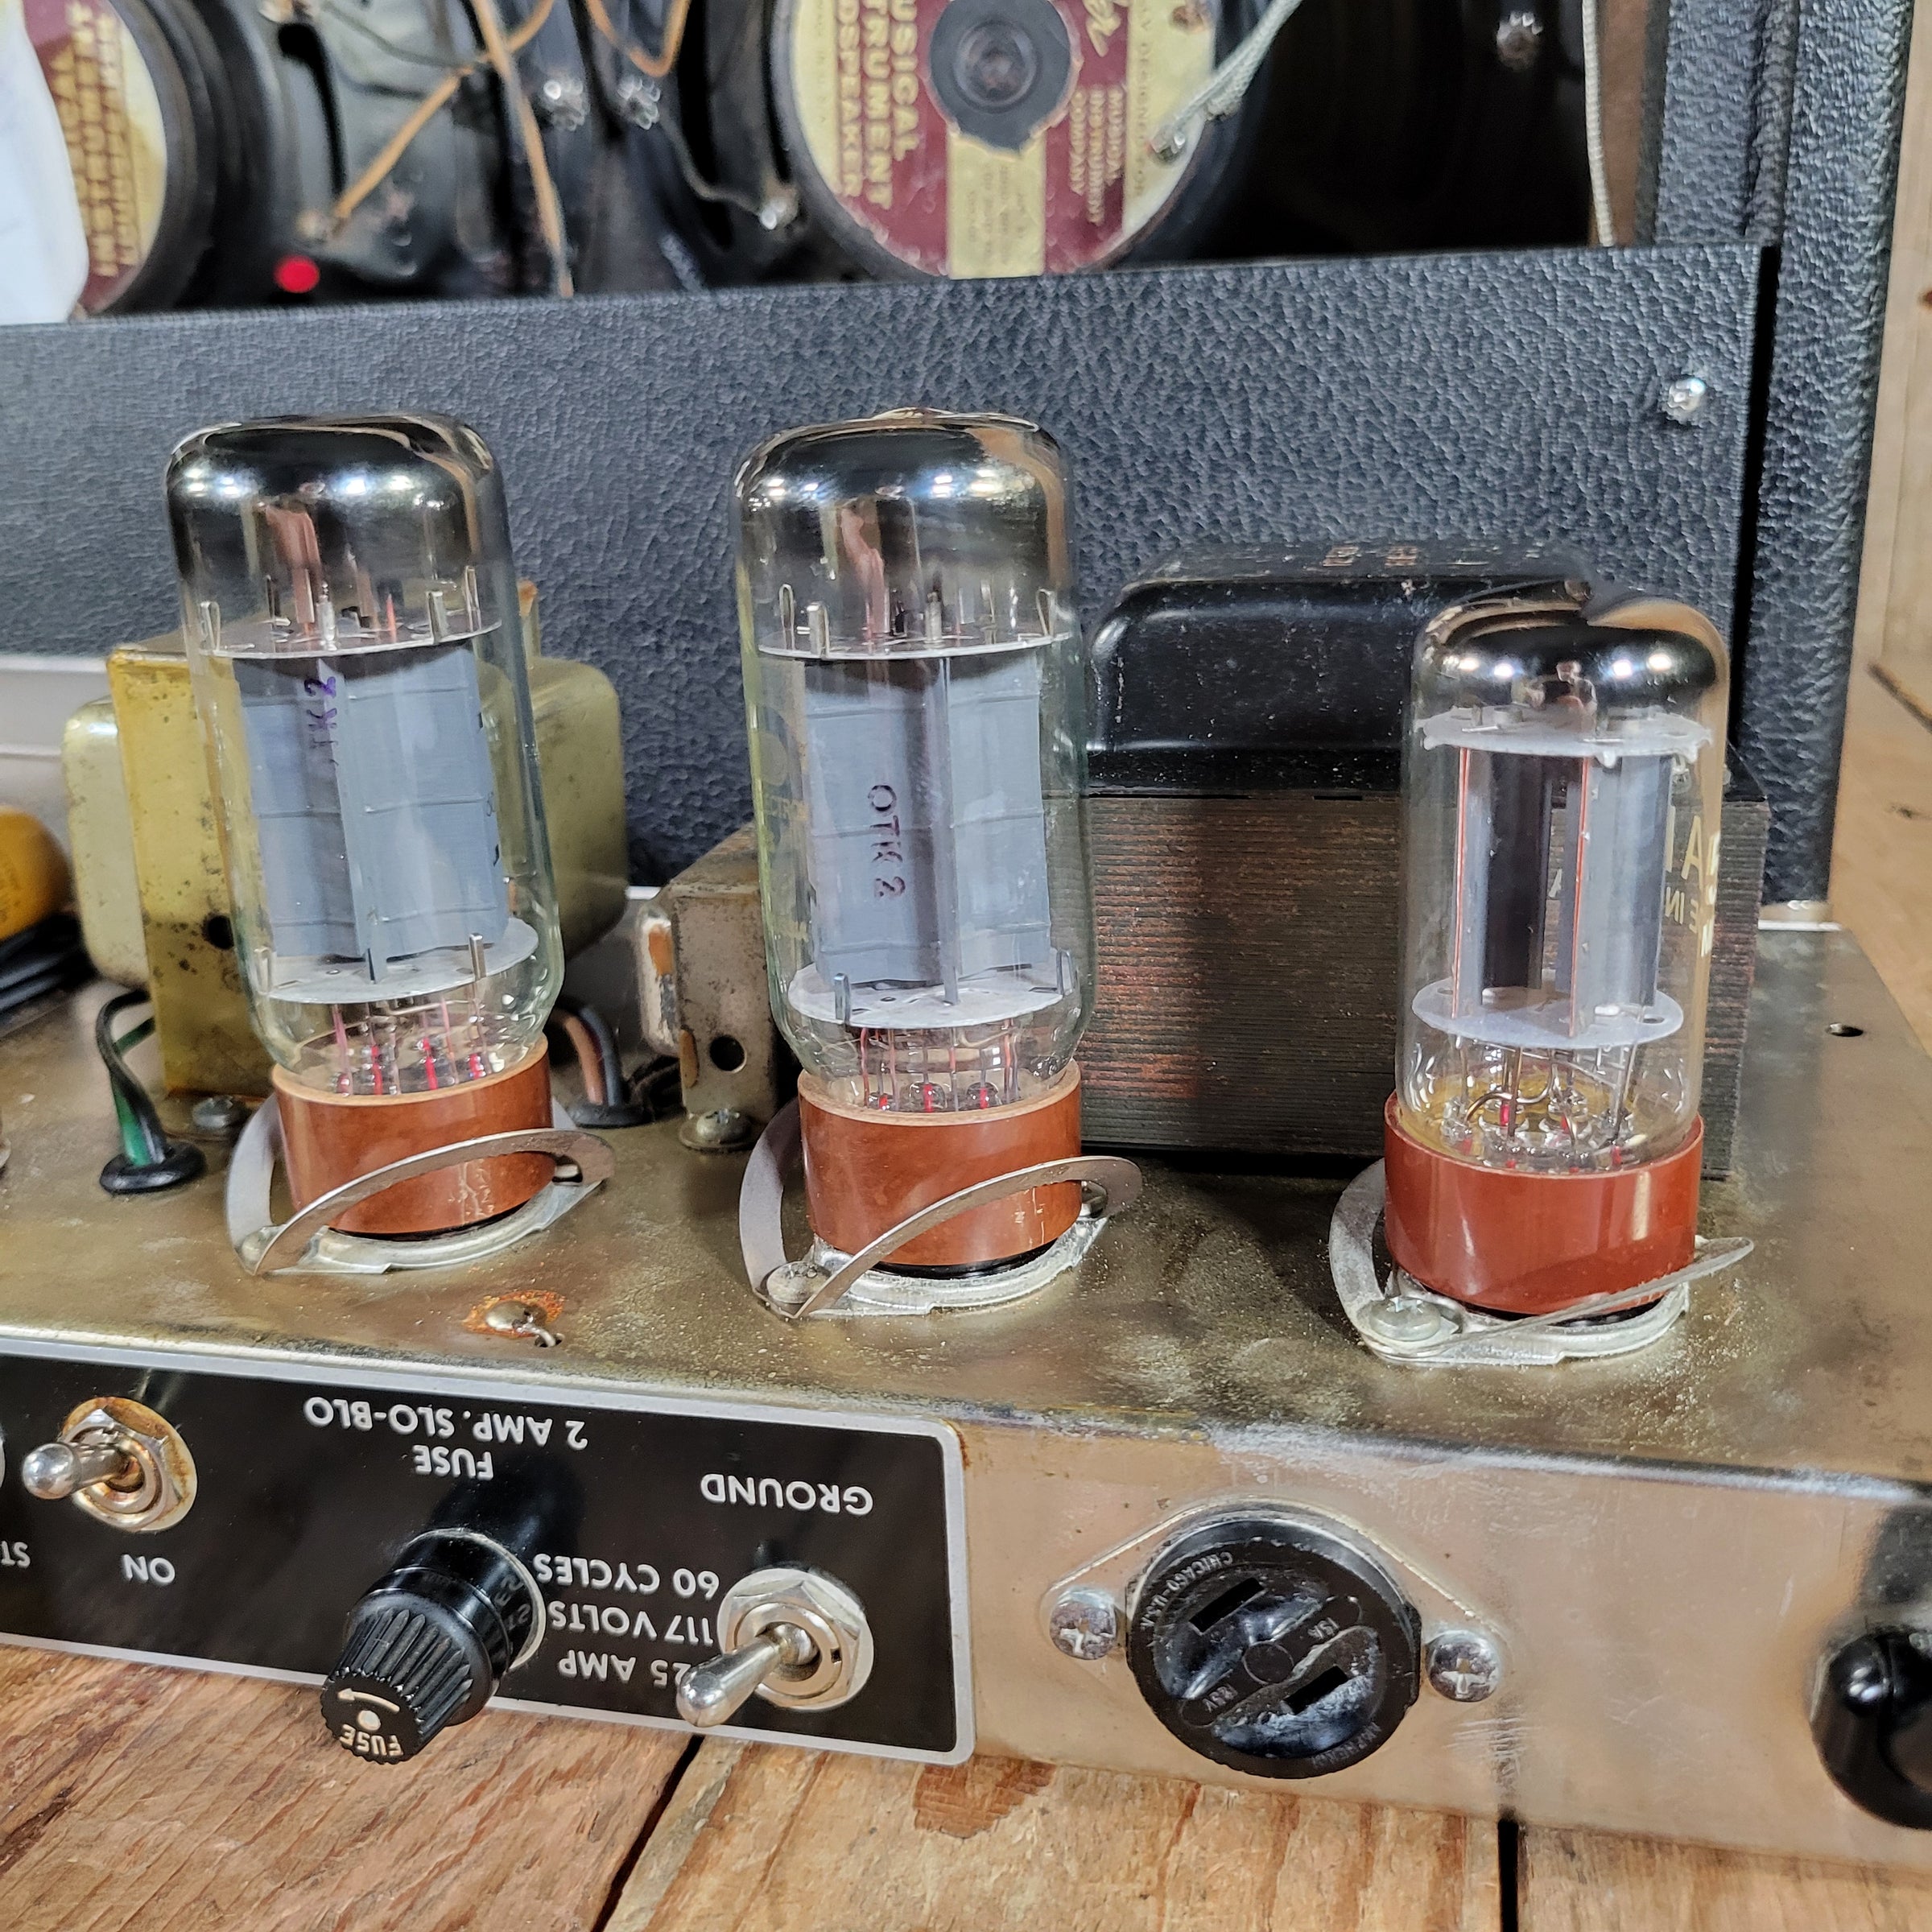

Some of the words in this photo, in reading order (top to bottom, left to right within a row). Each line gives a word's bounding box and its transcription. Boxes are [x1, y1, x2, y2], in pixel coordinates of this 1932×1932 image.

[305, 1396, 456, 1438] SLO-BLO
[462, 1409, 551, 1447] AMP.
[566, 1419, 588, 1449] 2
[413, 1444, 494, 1480] FUSE
[700, 1473, 874, 1516] GROUND
[122, 1554, 176, 1585] ON
[532, 1552, 661, 1594] CYCLES
[673, 1572, 720, 1600] 60
[551, 1600, 658, 1641] VOLTS
[664, 1615, 715, 1646] 117
[558, 1649, 636, 1683] AMP
[339, 1722, 405, 1757] FUSE
